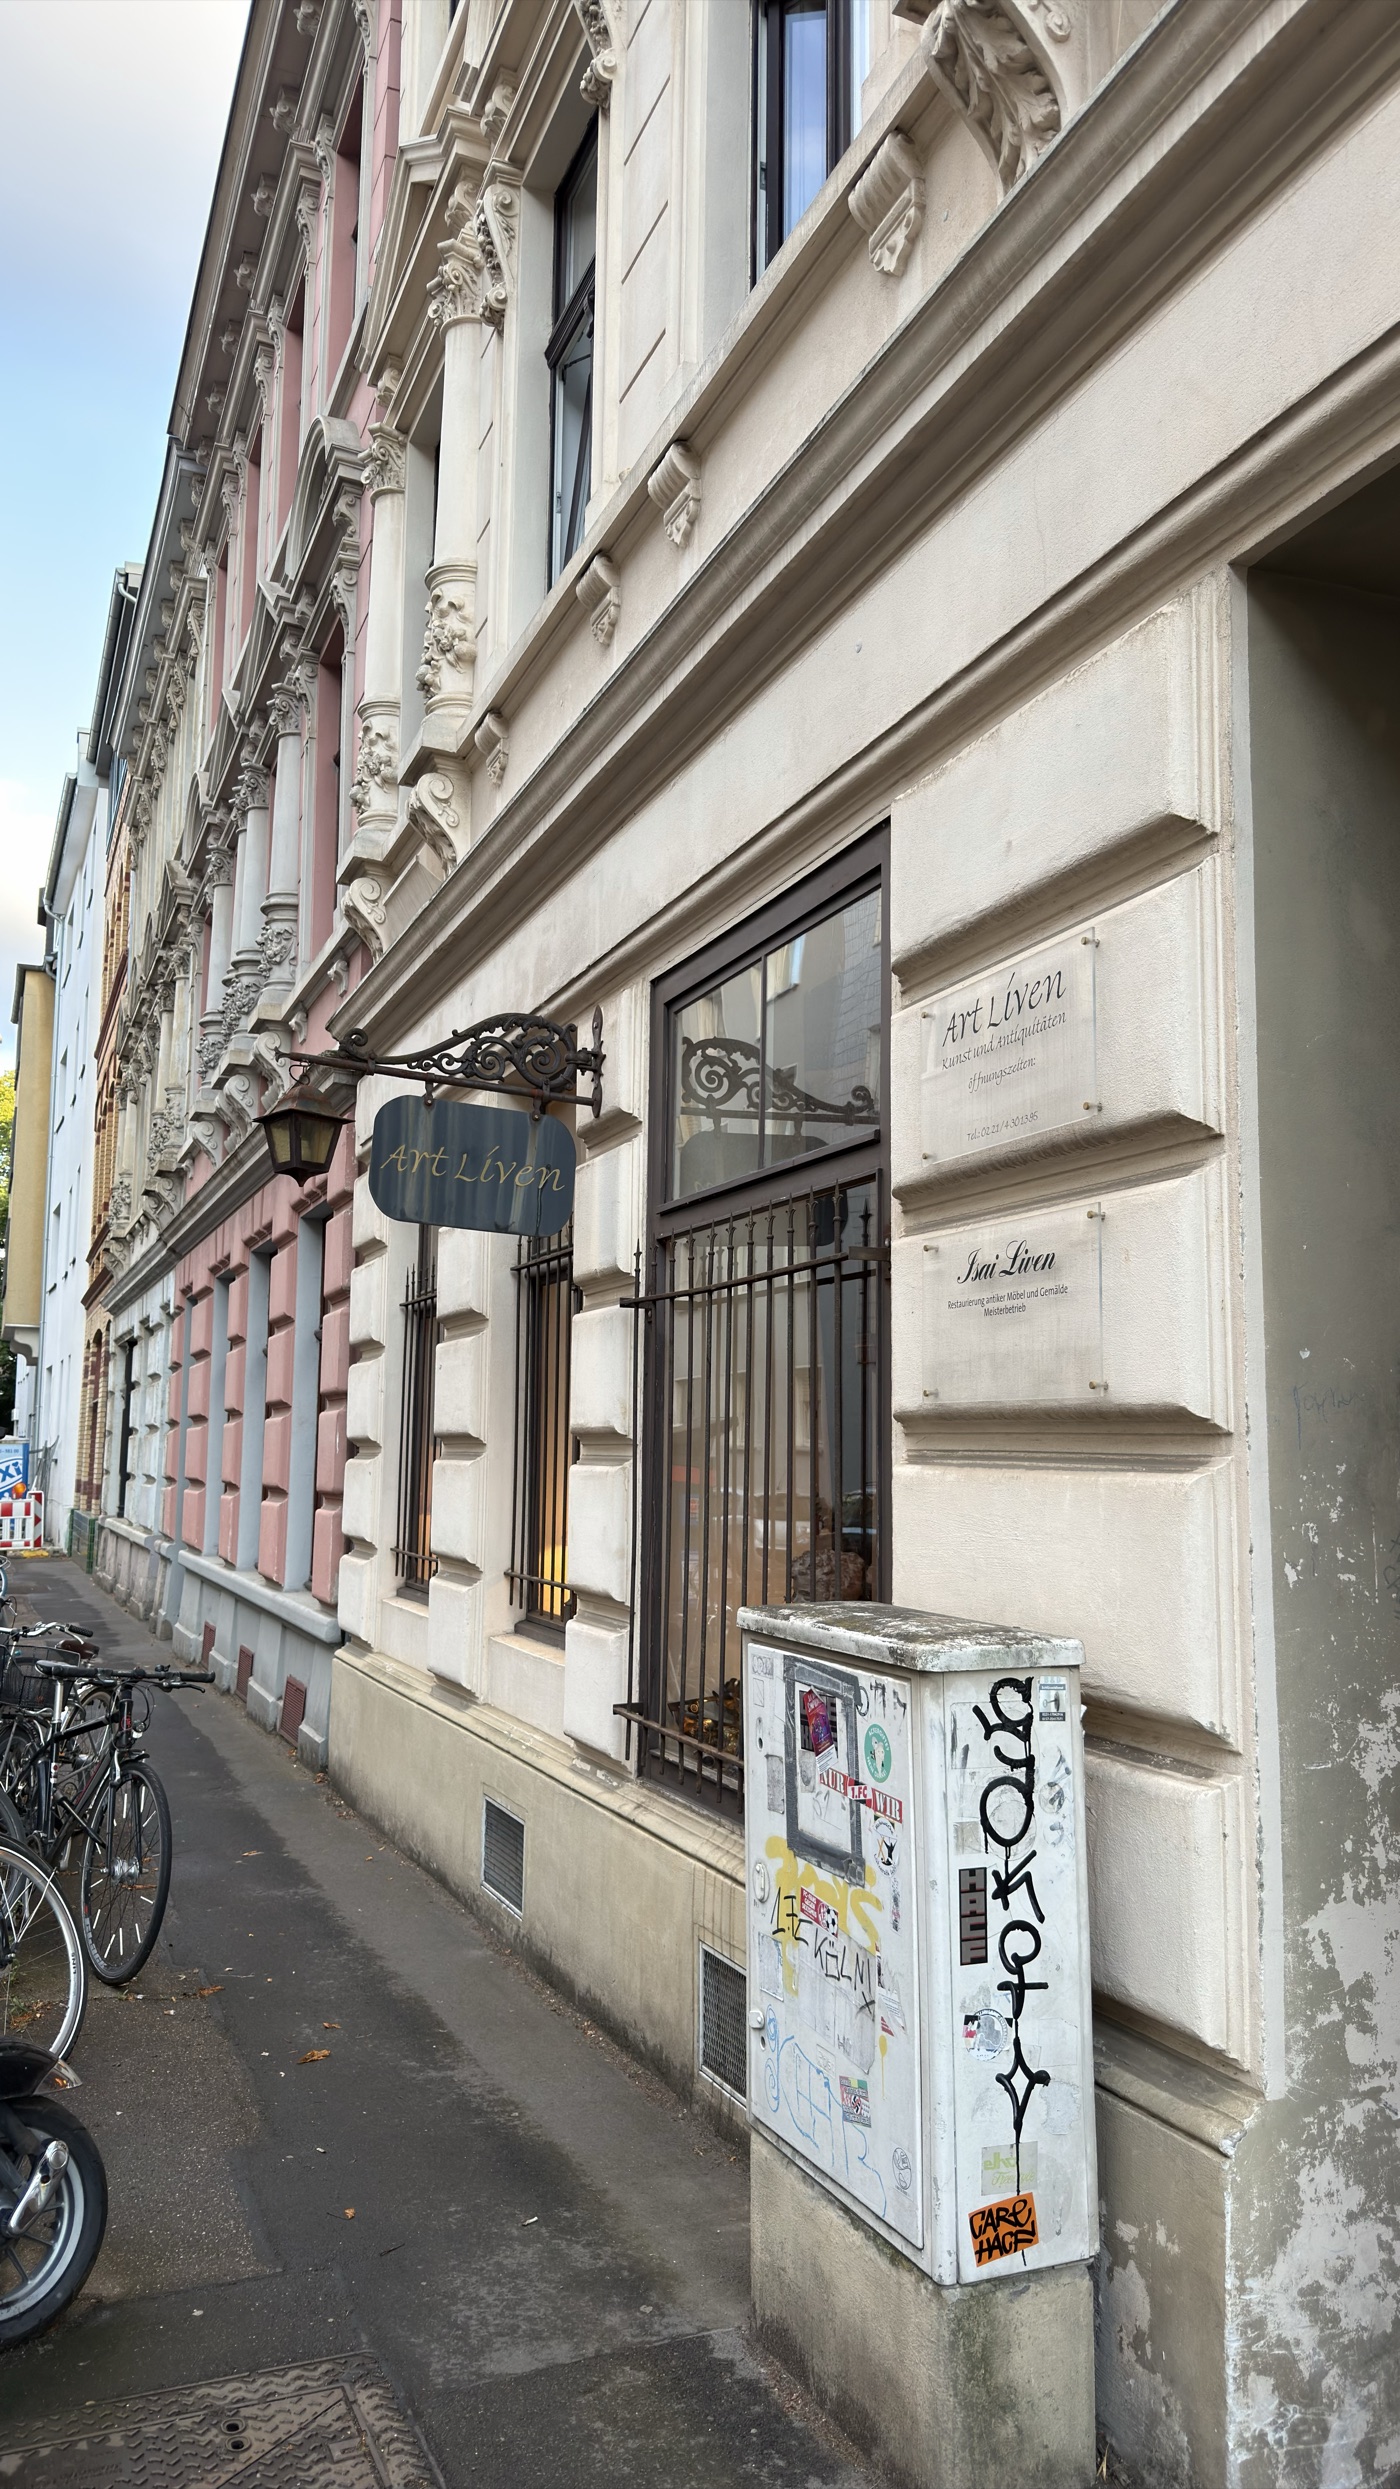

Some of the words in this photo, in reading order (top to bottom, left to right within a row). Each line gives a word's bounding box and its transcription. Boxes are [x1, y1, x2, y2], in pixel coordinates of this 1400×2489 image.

[943, 998, 982, 1047] Art
[942, 1048, 971, 1070] Kunst
[974, 1034, 994, 1058] und
[380, 1144, 449, 1177] Art
[957, 1248, 999, 1284] Isai
[999, 1240, 1056, 1277] Liven
[948, 1298, 985, 1309] Restaurierung
[986, 1293, 1005, 1304] antiker
[1007, 1290, 1025, 1301] Möbel
[1027, 1288, 1038, 1298] und
[1040, 1284, 1068, 1296] Gemälde
[984, 1303, 1026, 1316] Meisterbetrieb
